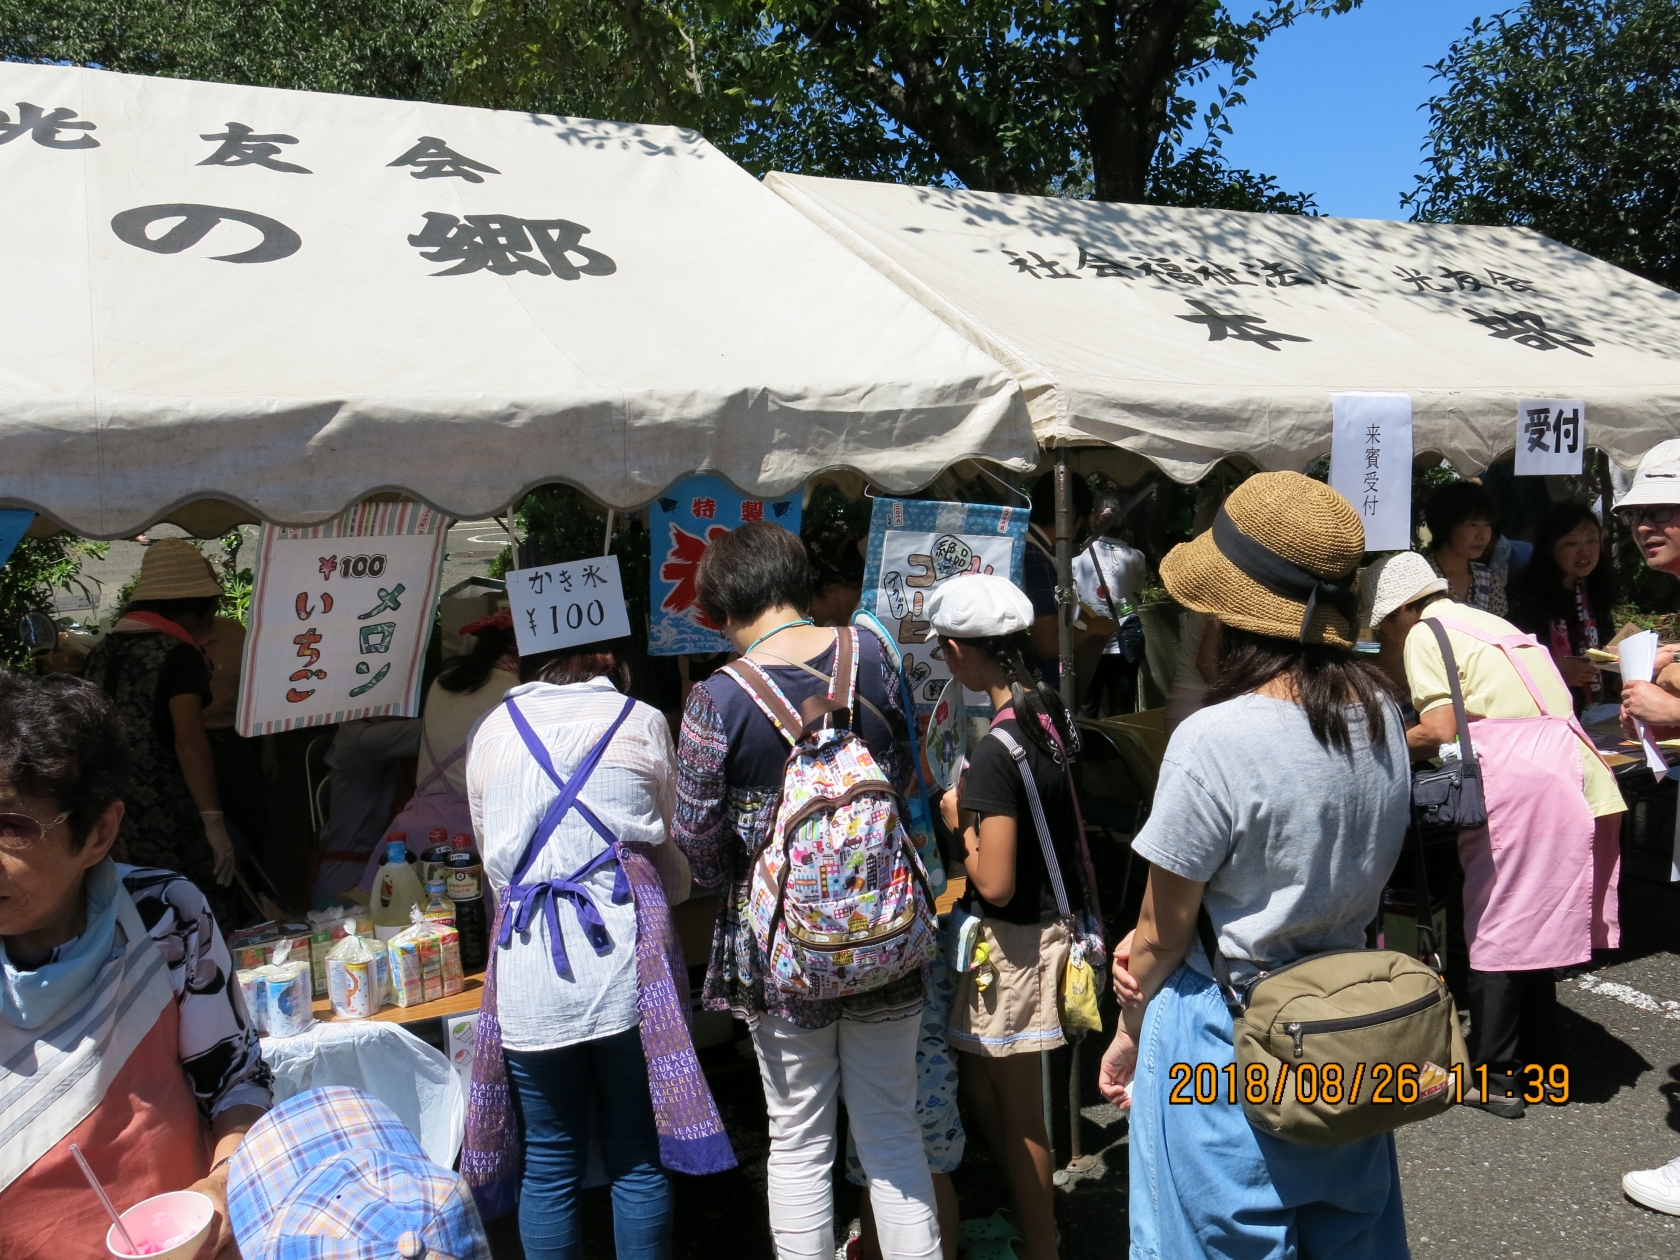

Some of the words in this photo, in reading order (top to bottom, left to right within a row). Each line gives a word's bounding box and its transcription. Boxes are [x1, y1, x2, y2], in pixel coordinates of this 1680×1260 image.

[111, 203, 617, 280] の郷
[1000, 247, 1361, 290] 社会福祉法人
[1391, 265, 1539, 293] 光友会
[1175, 299, 1596, 357] 本部
[1524, 408, 1579, 453] 受付
[1362, 423, 1381, 516] 来賓受付
[692, 497, 765, 523] 特製
[318, 554, 387, 581] ¥100
[935, 540, 968, 567] 絶品
[528, 564, 608, 596] かき氷
[349, 583, 406, 698] メロン
[526, 599, 605, 637] ¥100
[286, 591, 333, 703] いちご
